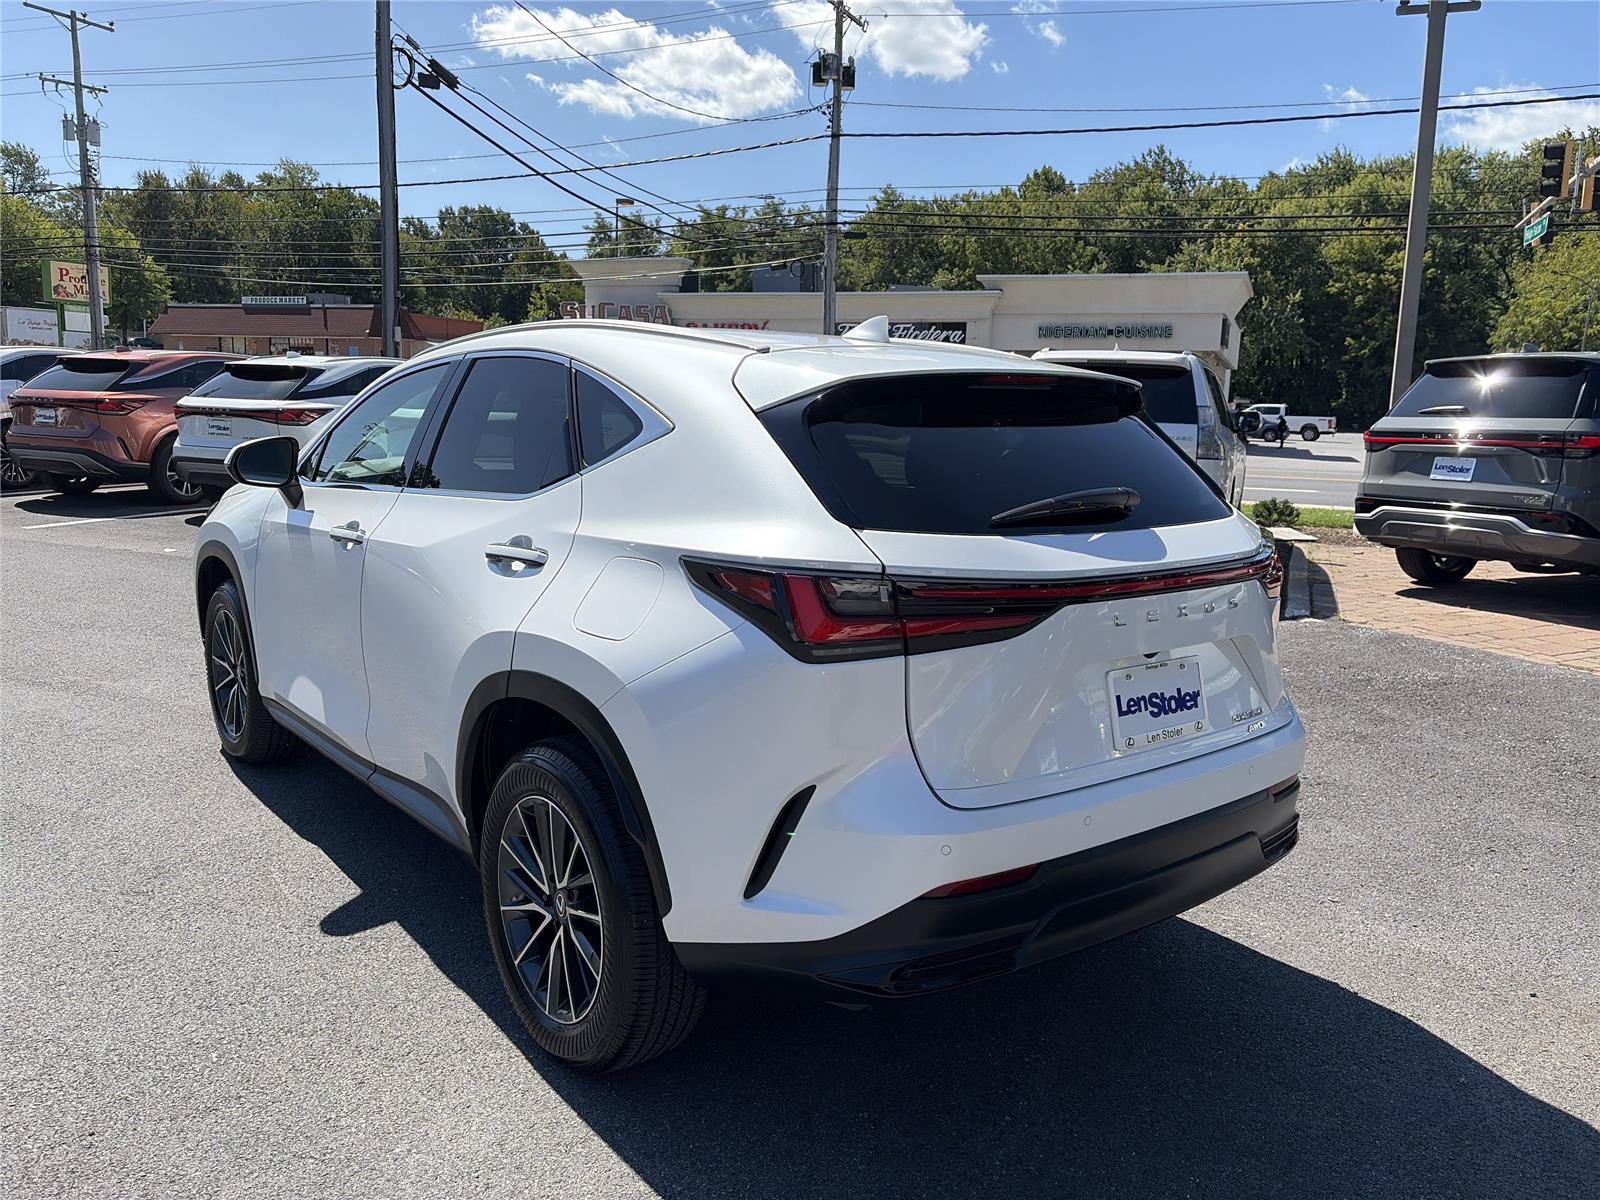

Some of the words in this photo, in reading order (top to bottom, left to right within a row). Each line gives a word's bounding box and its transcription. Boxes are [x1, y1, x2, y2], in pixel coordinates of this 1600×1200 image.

[1038, 324, 1107, 338] NIGERIAN
[1114, 324, 1173, 338] CUISINE
[1114, 599, 1238, 627] LEXUS
[1247, 721, 1264, 732] AWD
[1146, 733, 1160, 744] Len
[1162, 727, 1184, 740] Stoler
